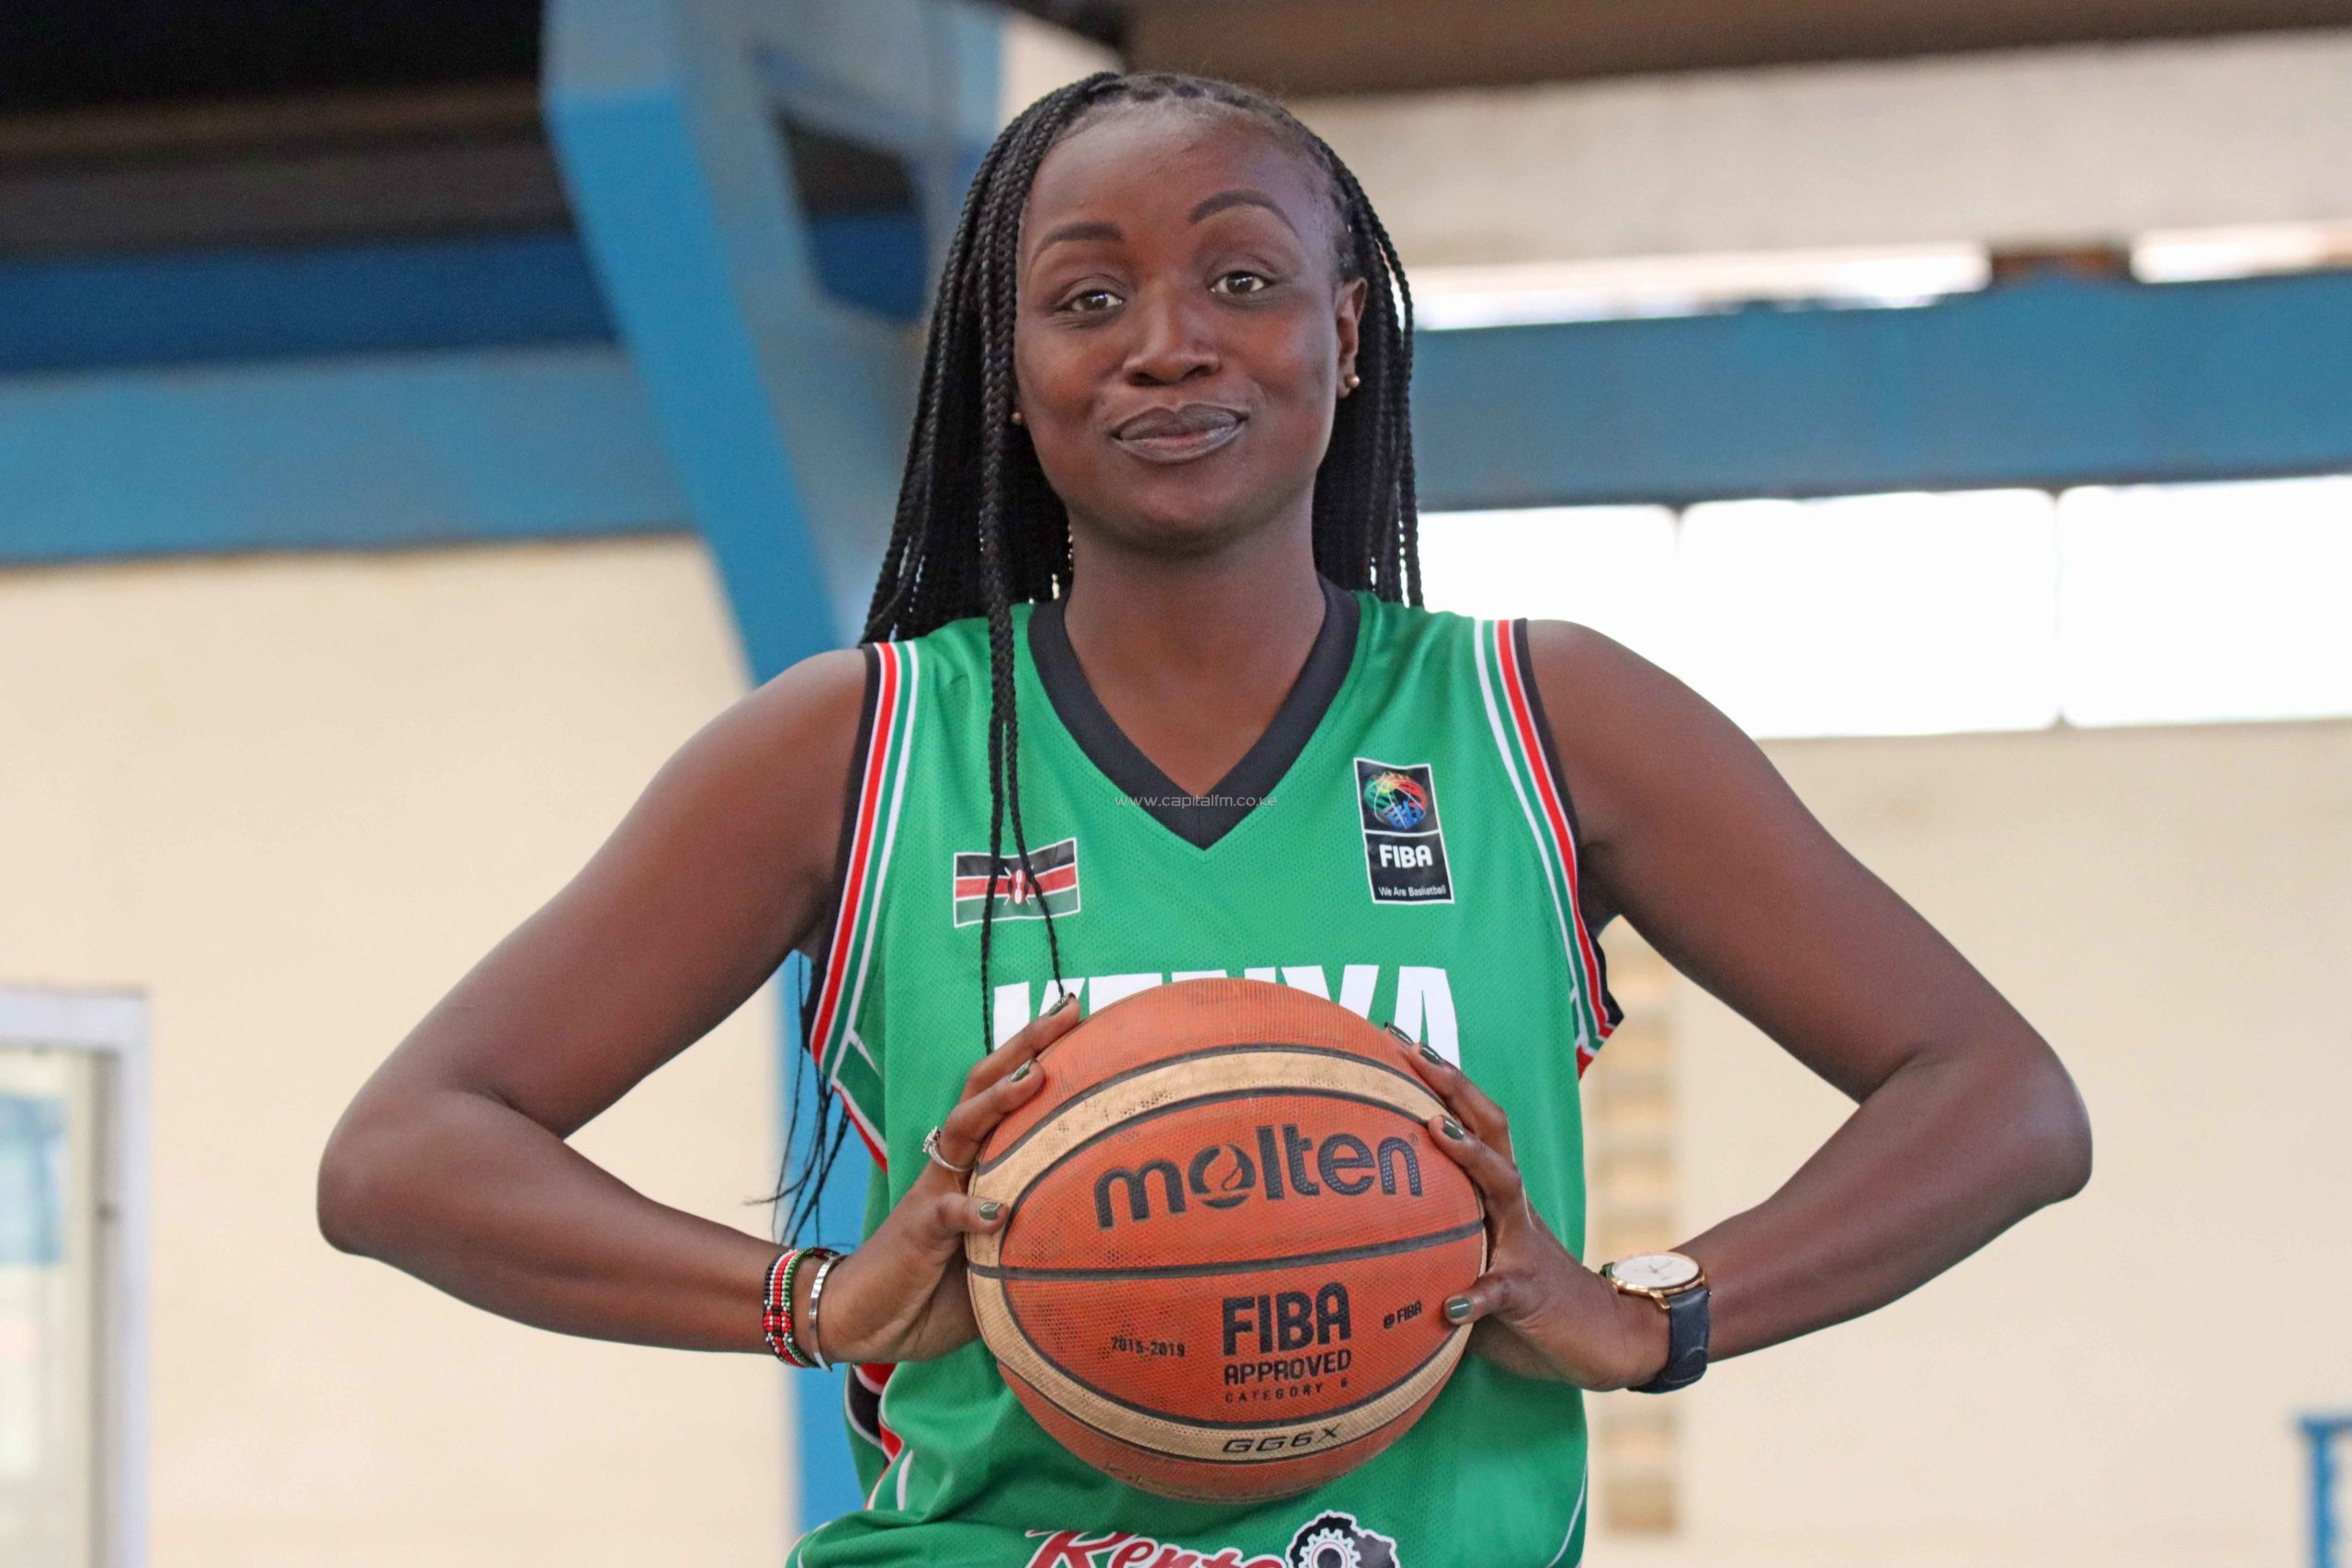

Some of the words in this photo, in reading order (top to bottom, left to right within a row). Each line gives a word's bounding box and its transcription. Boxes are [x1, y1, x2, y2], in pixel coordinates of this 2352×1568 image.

[1379, 844, 1433, 868] FIBA
[1378, 886, 1392, 897] We
[1393, 886, 1407, 897] Are
[1408, 885, 1446, 897] Basketball
[1093, 1123, 1423, 1231] molten
[1222, 1281, 1351, 1356] FIBA
[1224, 1348, 1351, 1385] APPROVED
[1225, 1383, 1323, 1404] CATEGORY
[1222, 1421, 1344, 1453] GG6X
